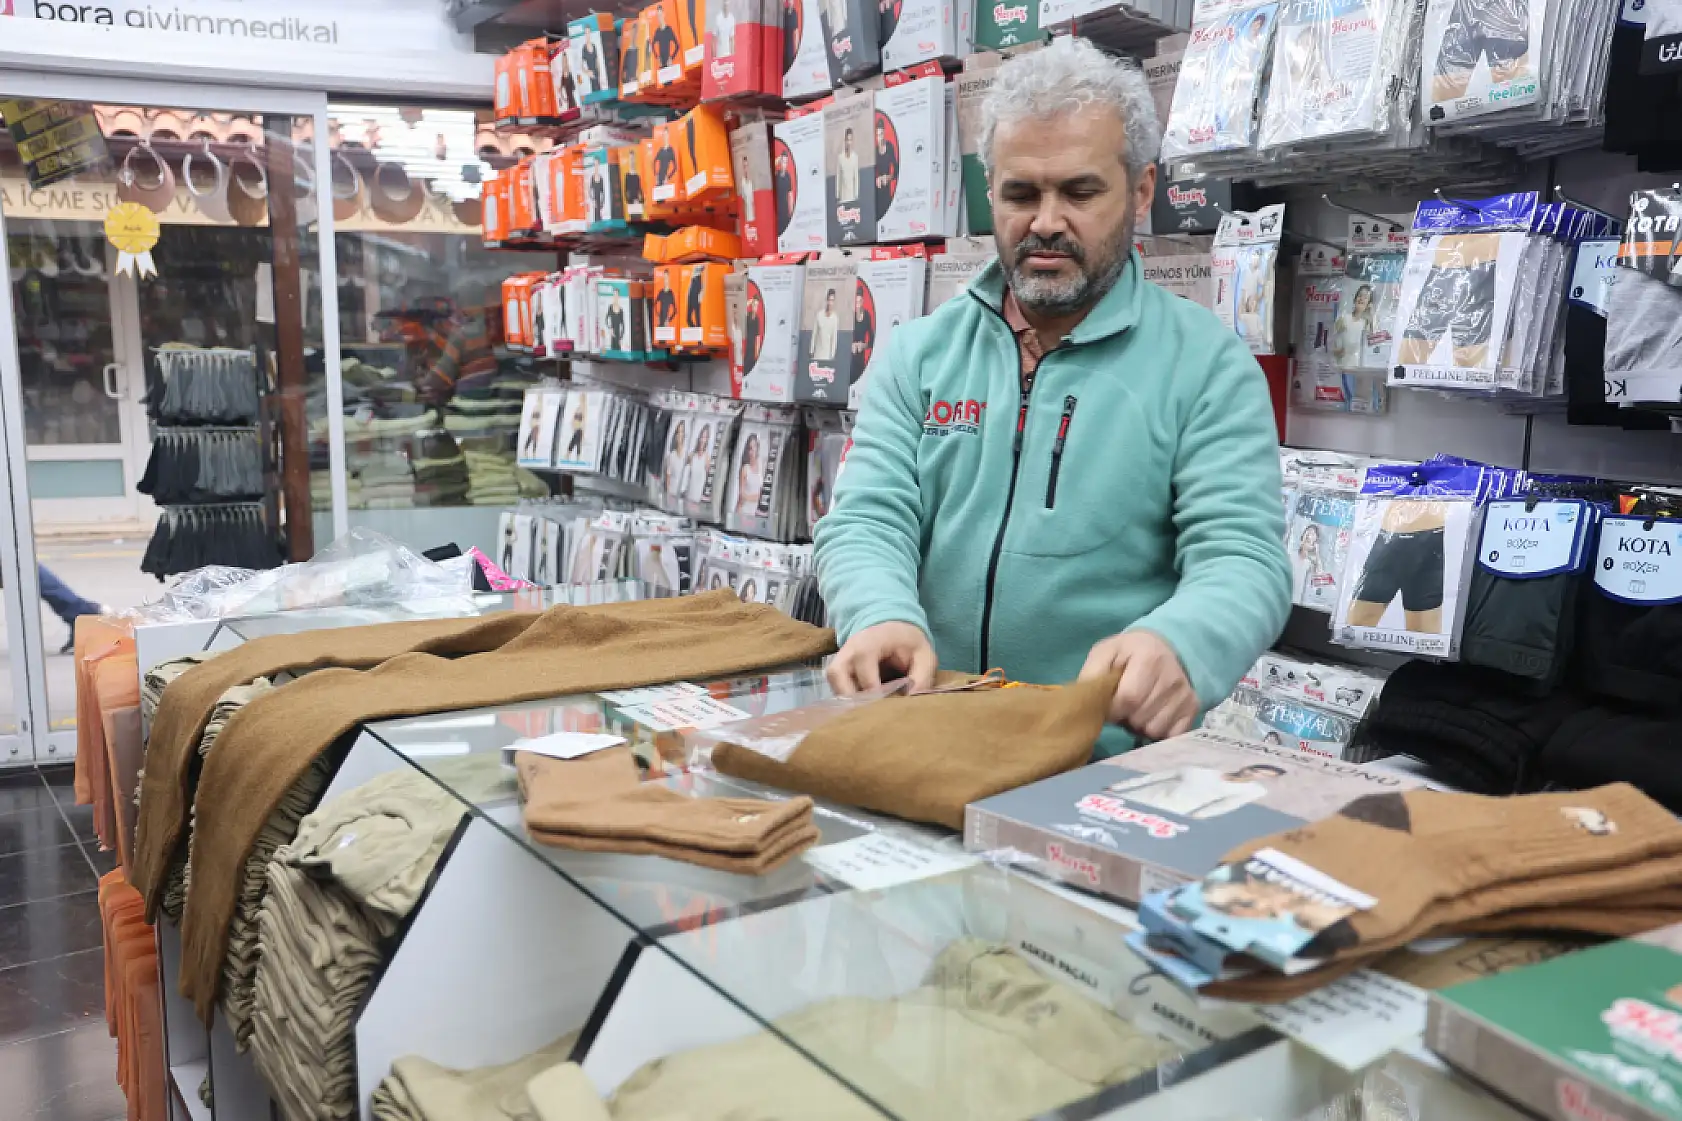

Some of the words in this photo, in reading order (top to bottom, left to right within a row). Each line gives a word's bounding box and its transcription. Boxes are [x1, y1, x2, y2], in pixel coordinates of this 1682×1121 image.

[34, 0, 114, 26] bora
[1143, 266, 1183, 280] ERİNOS
[1503, 517, 1551, 532] KOTA
[1506, 538, 1539, 550] BOXER
[1618, 536, 1672, 557] KOTA
[1623, 560, 1660, 574] BOXER
[1363, 632, 1416, 646] FEELLINE
